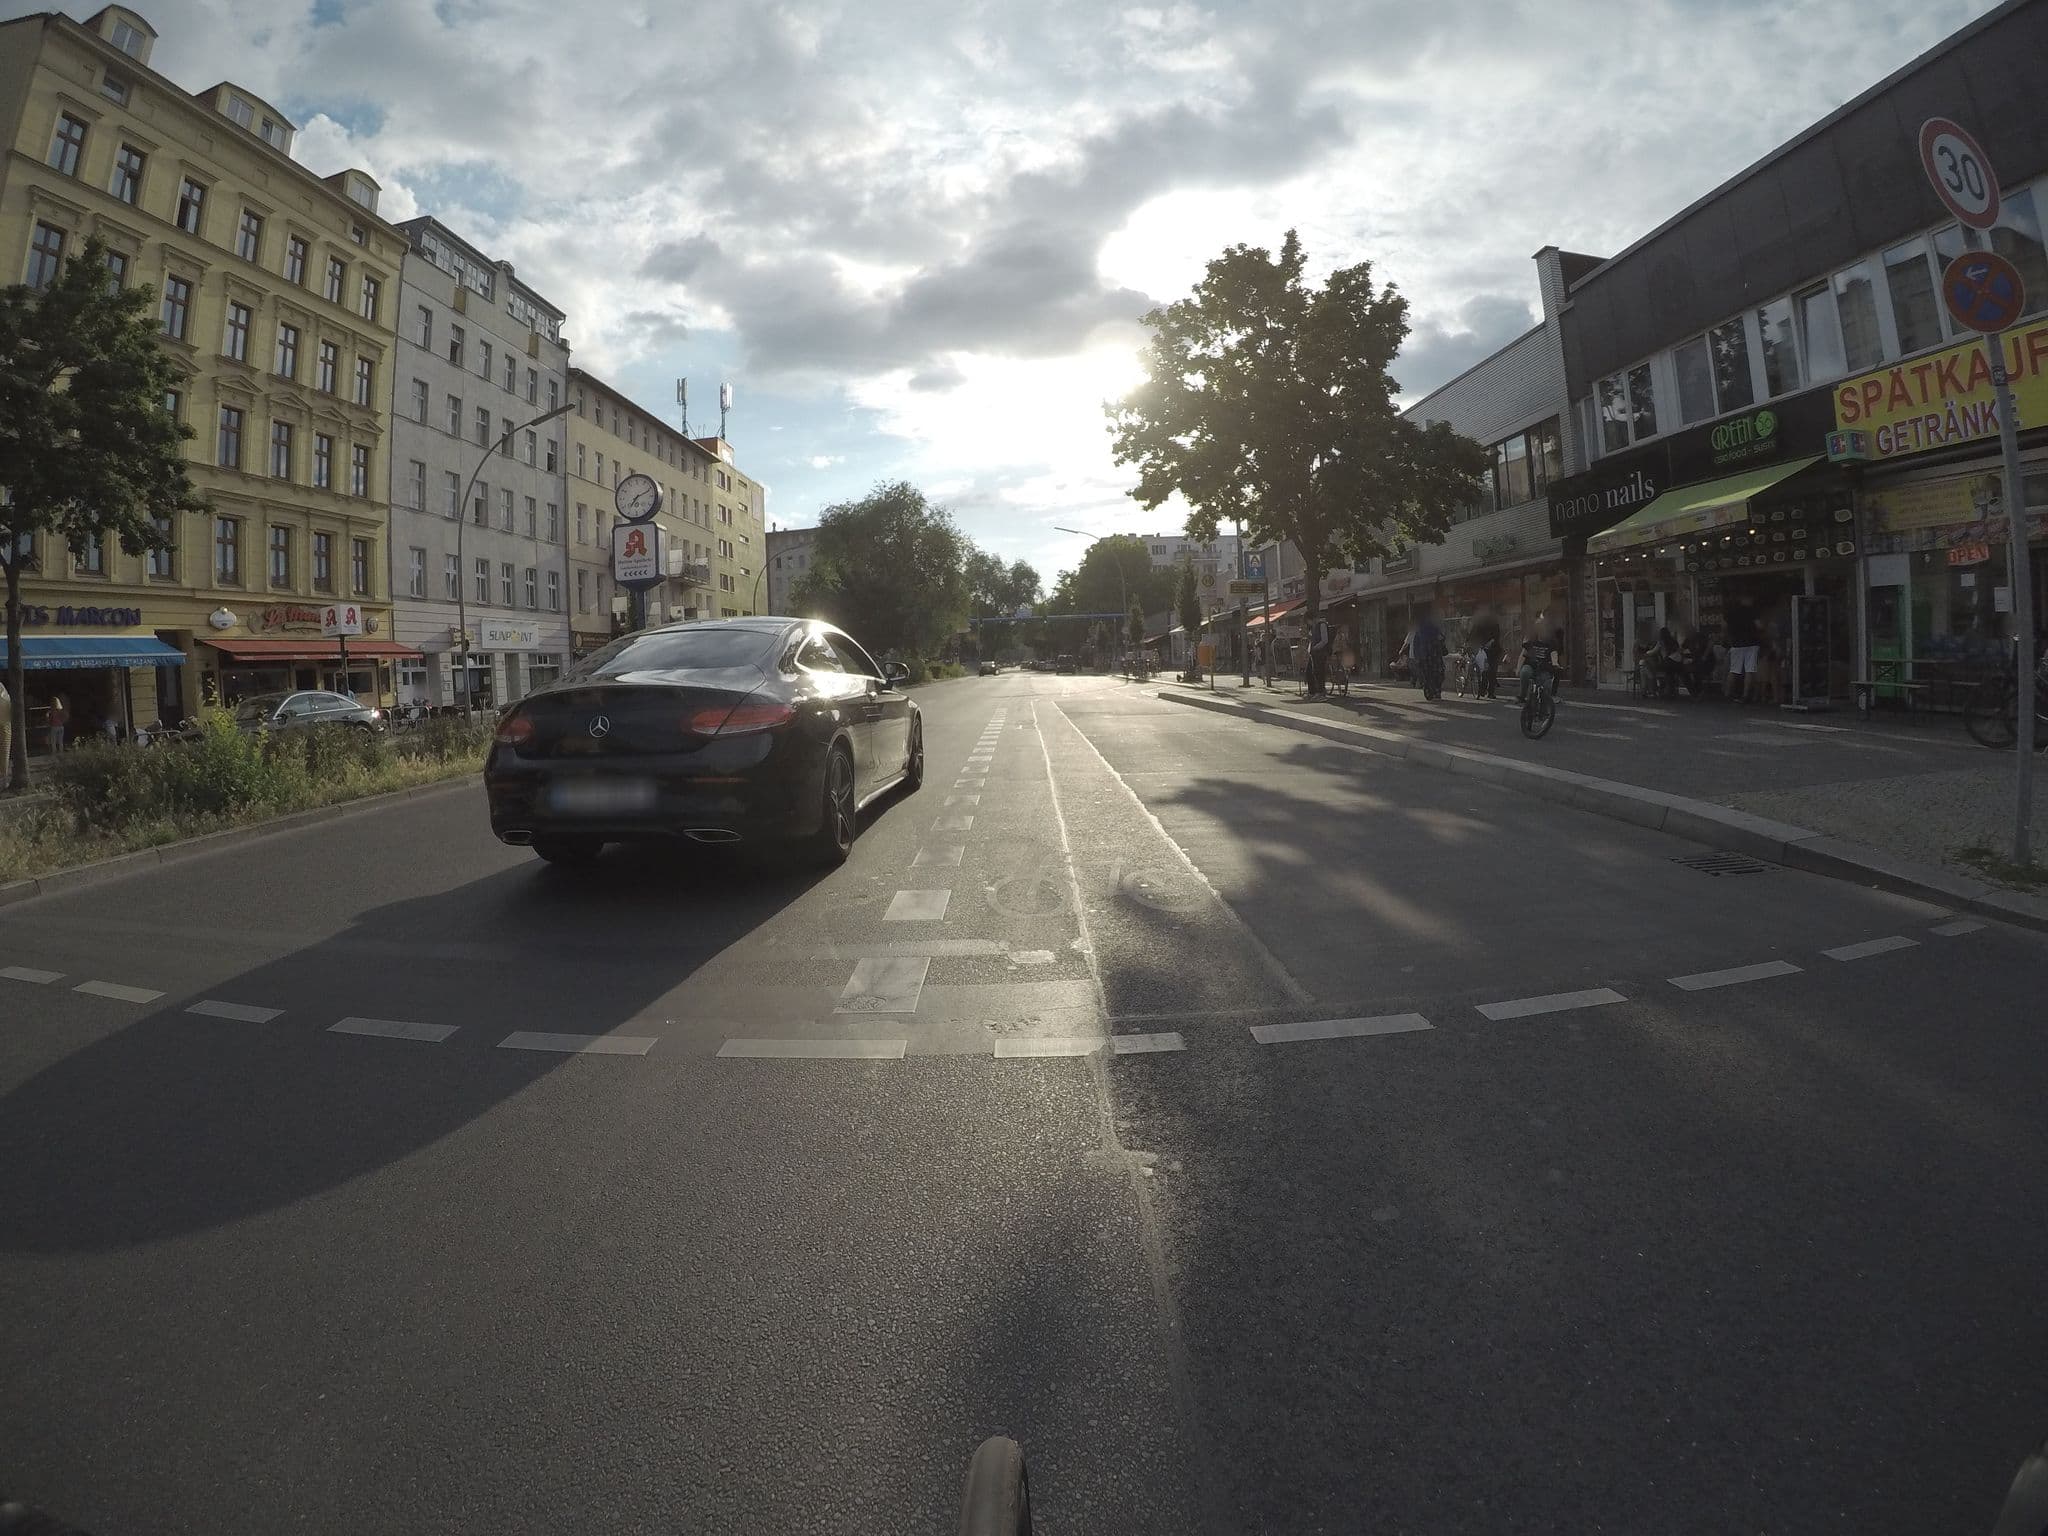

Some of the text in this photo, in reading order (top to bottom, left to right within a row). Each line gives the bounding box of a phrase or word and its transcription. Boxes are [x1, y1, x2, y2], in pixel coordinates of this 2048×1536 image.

[1938, 145, 1985, 201] 30
[1839, 327, 2048, 424] SPÄTKAUF
[1711, 416, 1753, 450] GREEN
[1554, 470, 1655, 521] nano nails
[1945, 544, 1989, 565] OPEN
